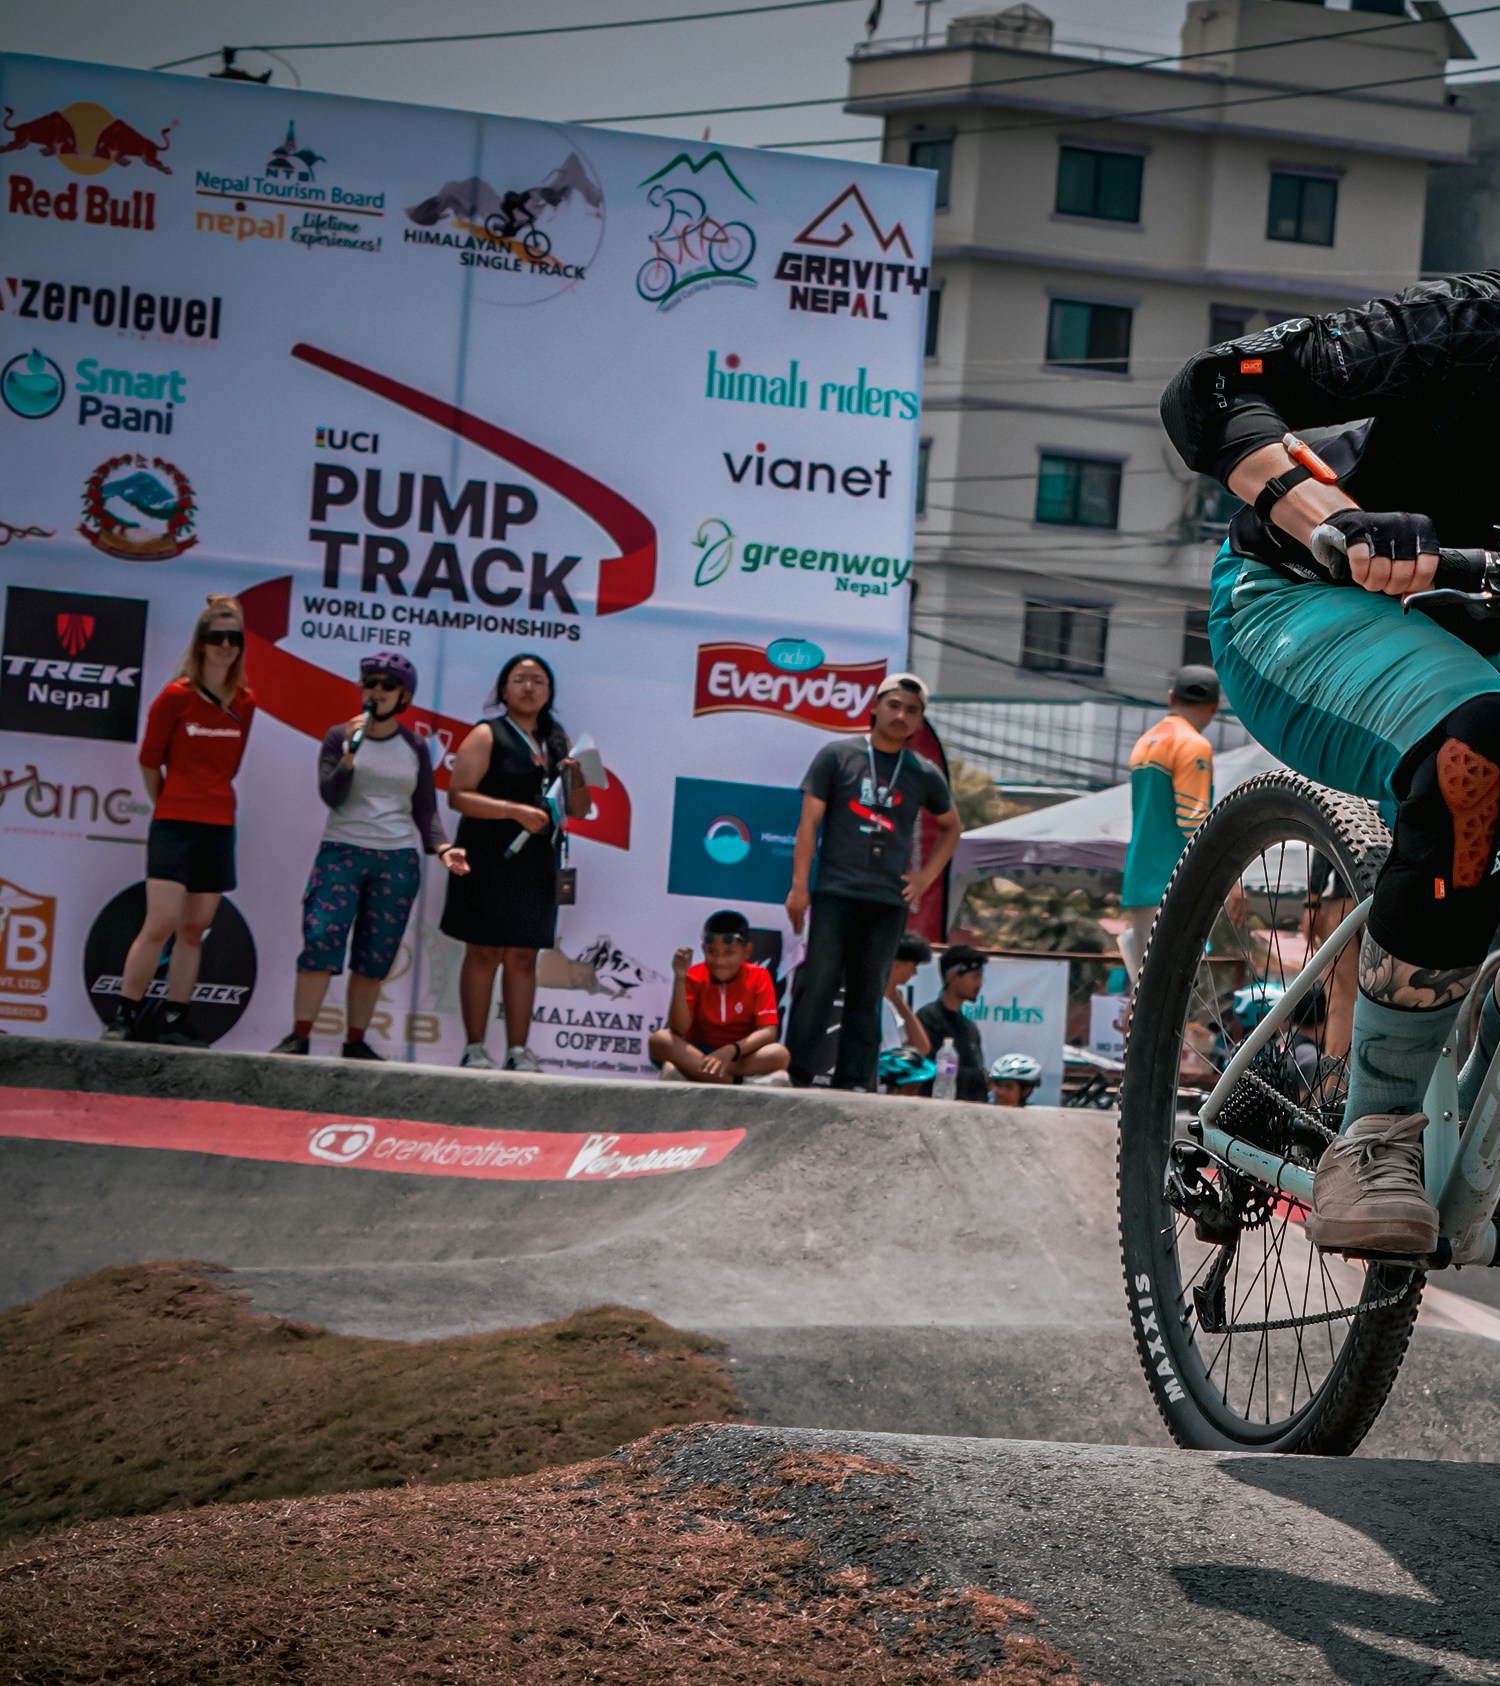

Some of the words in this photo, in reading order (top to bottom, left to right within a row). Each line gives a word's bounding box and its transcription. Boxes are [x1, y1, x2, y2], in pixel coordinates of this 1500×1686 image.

[8, 174, 77, 221] Red
[85, 187, 157, 232] Bull
[196, 170, 250, 193] Nepal
[253, 177, 326, 201] Tourism
[330, 186, 385, 209] Board
[195, 209, 286, 242] nepal
[302, 211, 360, 234] Lifetime
[403, 228, 513, 255] HIMALAYAN
[459, 251, 522, 273] SINGLE
[528, 260, 587, 281] TRACK
[774, 251, 930, 296] GRAVITY
[18, 278, 223, 341] zerolevel
[789, 284, 889, 321] NEPAL
[75, 357, 188, 405] Smart
[705, 349, 809, 409] himali
[819, 366, 920, 421] riders
[78, 395, 175, 436] Paani
[326, 428, 380, 454] UCI
[722, 441, 893, 500] vianet
[309, 462, 539, 542] PUMP
[307, 527, 584, 616] TRACK
[739, 542, 915, 589] greenway
[834, 576, 890, 598] Nepal
[300, 619, 412, 648] QUALIFIER
[303, 595, 386, 624] WORLD
[391, 605, 582, 642] CHAMPIONSHIPS
[2, 654, 141, 688] TREK
[707, 660, 877, 721] Everyday
[27, 682, 111, 712] Nepal
[496, 1002, 644, 1032] MALAYAN
[555, 1030, 642, 1055] COFFEE
[373, 1136, 540, 1167] crankbrothers
[1134, 1272, 1186, 1404] MAXXIS
